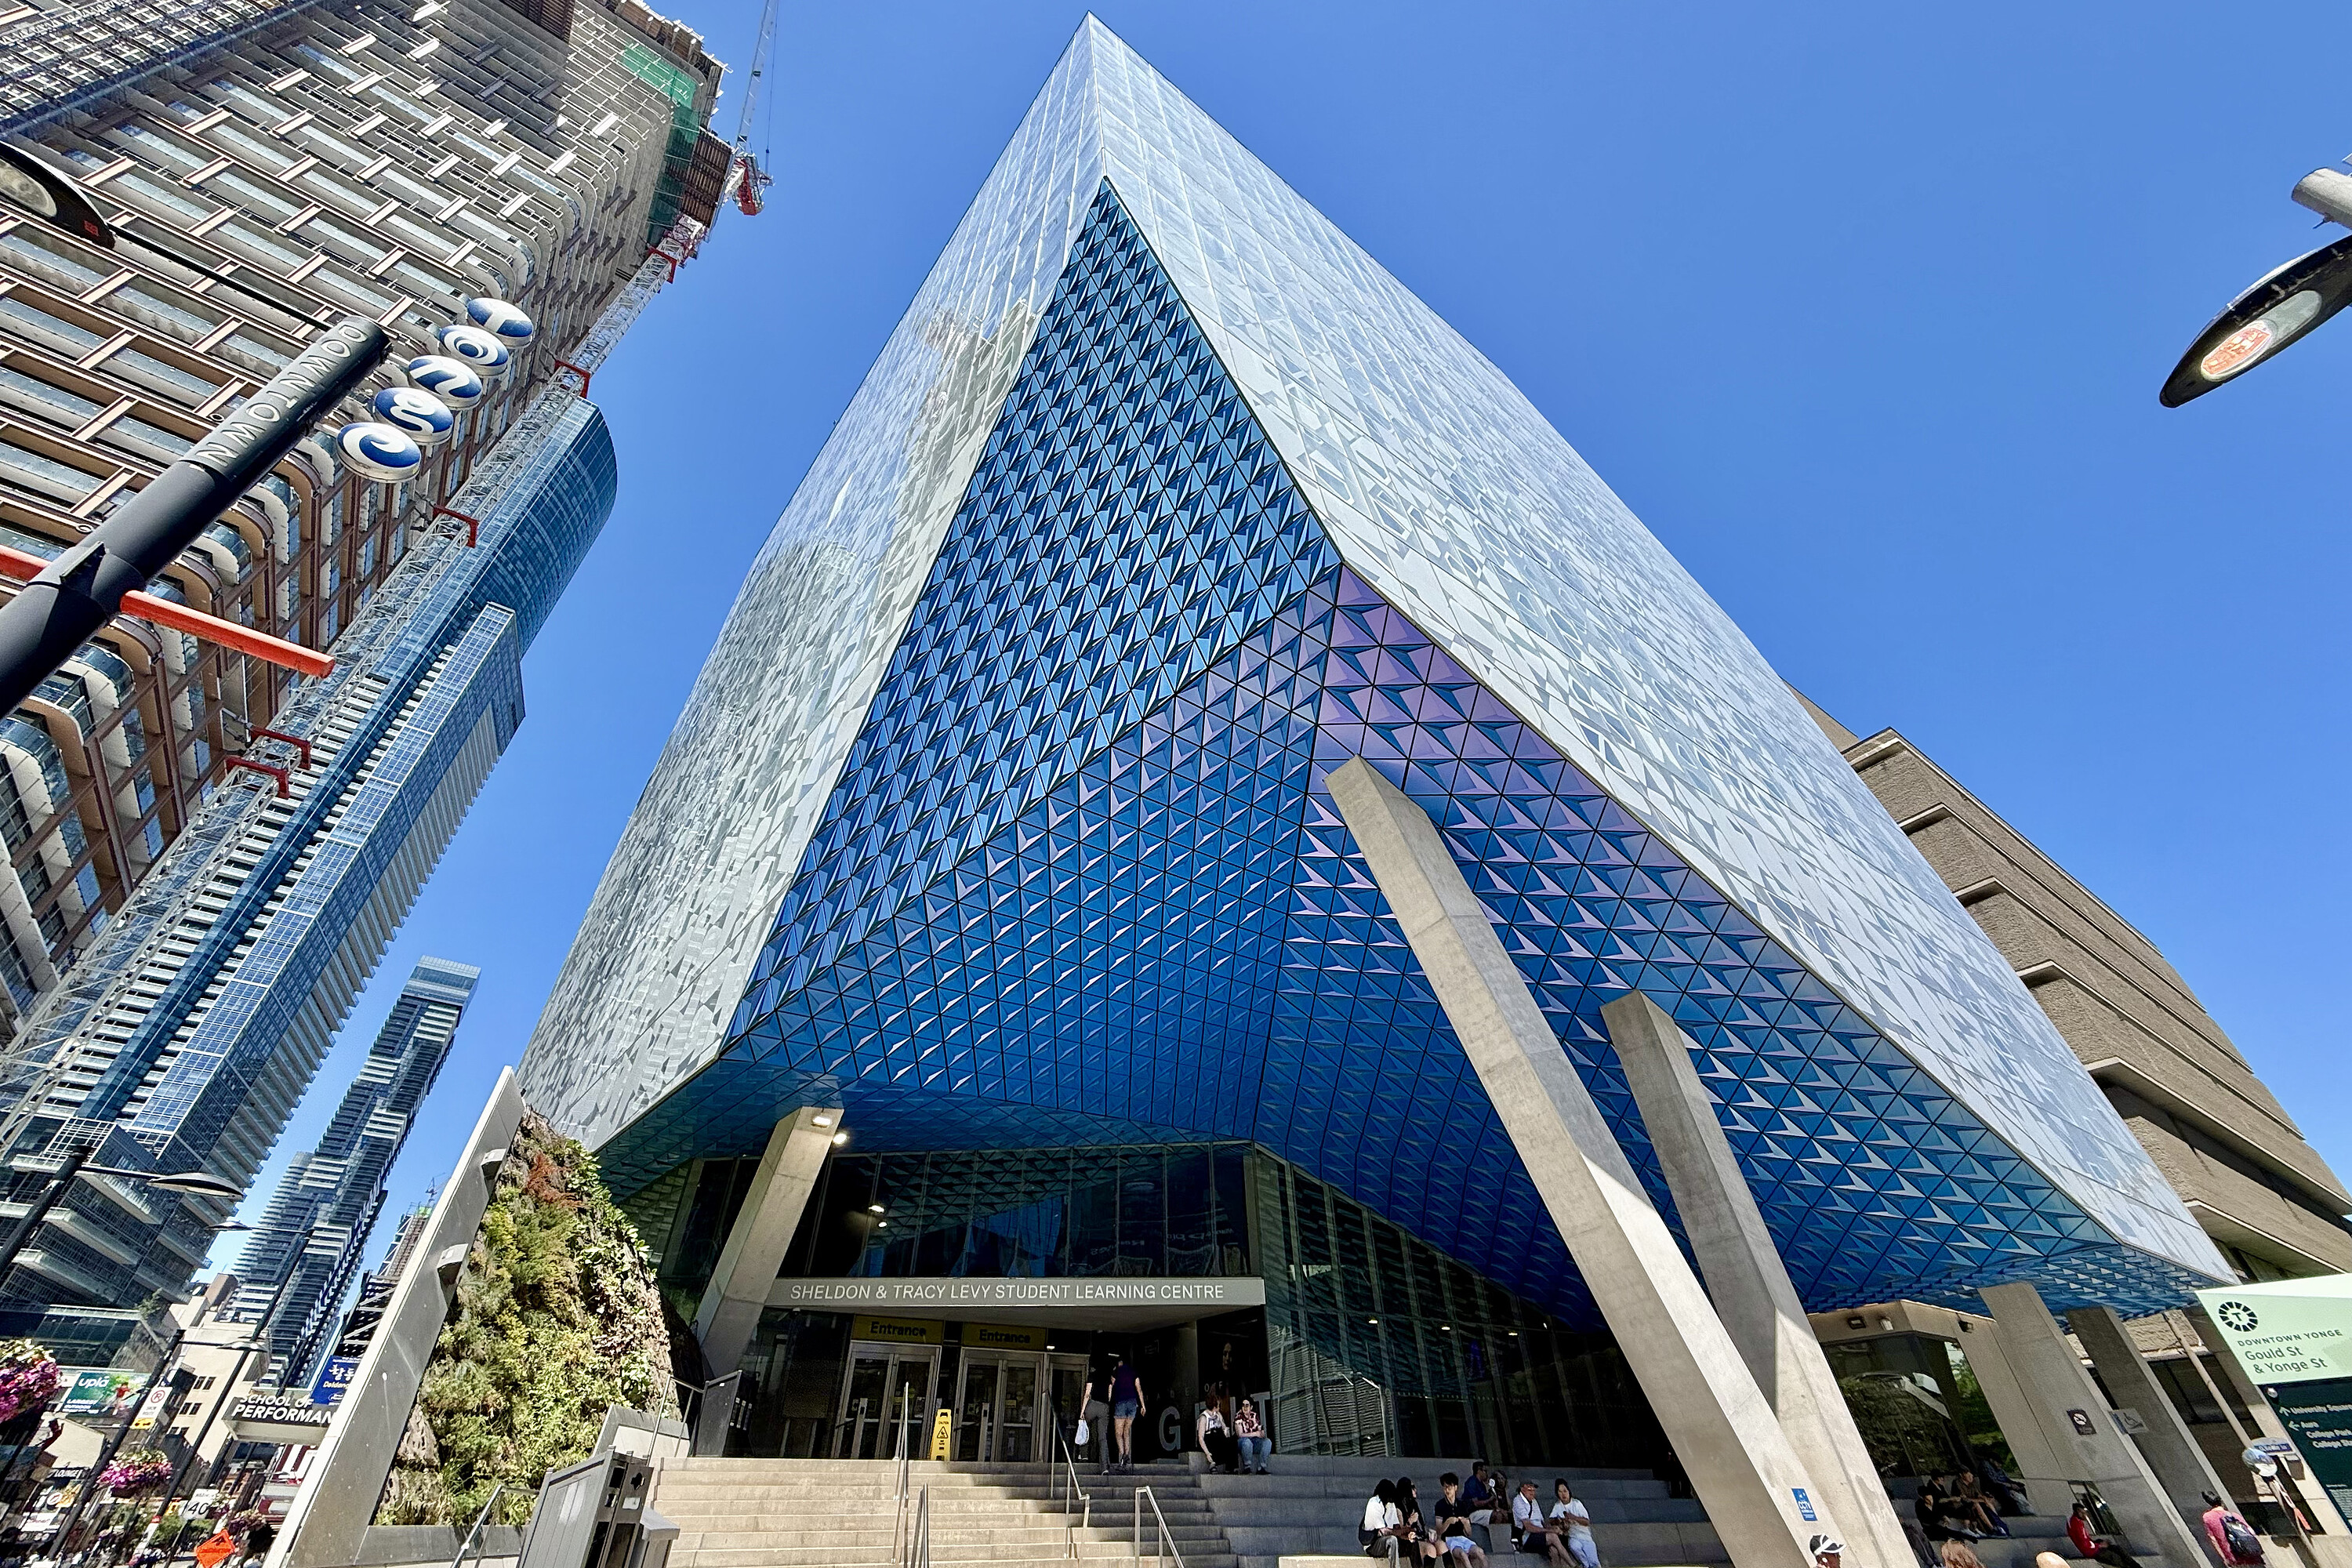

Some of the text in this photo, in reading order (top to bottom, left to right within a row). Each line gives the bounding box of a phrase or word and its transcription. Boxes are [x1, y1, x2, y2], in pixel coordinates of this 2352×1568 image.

[196, 325, 368, 467] DOWNTOWN
[791, 1285, 1224, 1300] SHELDON & TRACY LEVY STUDENT LEARNING CENTRE
[870, 1322, 927, 1338] Entrance
[979, 1329, 1031, 1344] Entrance
[2237, 1329, 2343, 1347] DOWNTOWN YONGE
[2245, 1345, 2303, 1361] Gould St
[2253, 1357, 2328, 1374] & Yonge St
[1204, 1381, 1223, 1392] OF
[240, 1393, 291, 1406] SCHOOL
[294, 1397, 314, 1409] OF
[188, 1501, 209, 1515] 40
